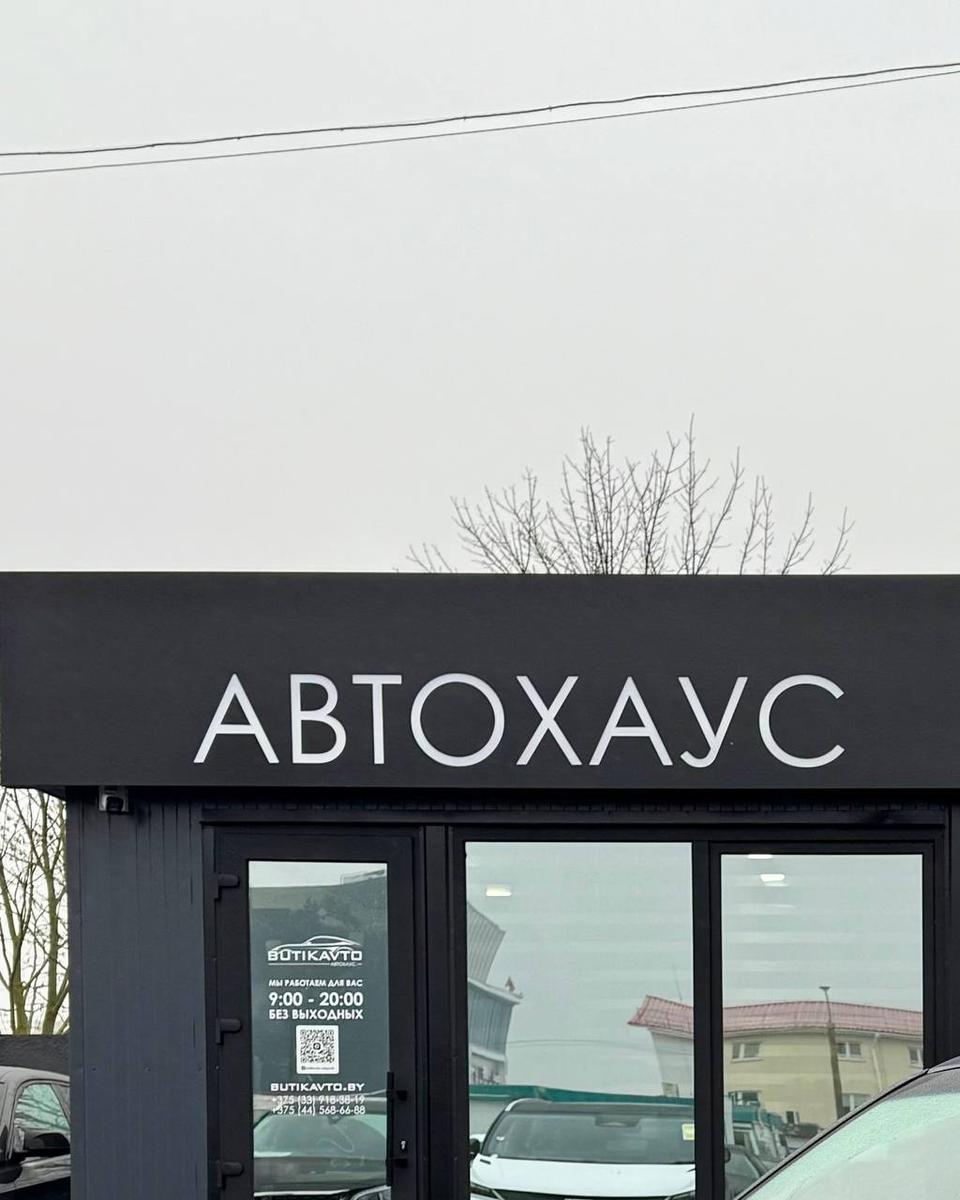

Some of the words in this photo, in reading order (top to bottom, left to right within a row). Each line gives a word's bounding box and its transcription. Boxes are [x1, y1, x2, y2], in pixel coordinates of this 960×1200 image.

[193, 672, 846, 768] АВТОХАУС
[268, 950, 363, 961] BUTIKAVTO
[268, 979, 283, 987] МЫ
[284, 979, 327, 987] РАБОТАЕМ
[328, 979, 344, 988] ДЛЯ
[346, 979, 363, 987] ВАС
[268, 992, 303, 1006] 9:00
[319, 992, 363, 1006] 20:00
[269, 1009, 288, 1019] БЕЗ
[292, 1009, 363, 1020] ВЫХОДНЫХ
[270, 1083, 365, 1092] BUTIKAVTO.BY
[297, 1105, 316, 1116] (44)
[319, 1106, 366, 1115] 568-66-88
